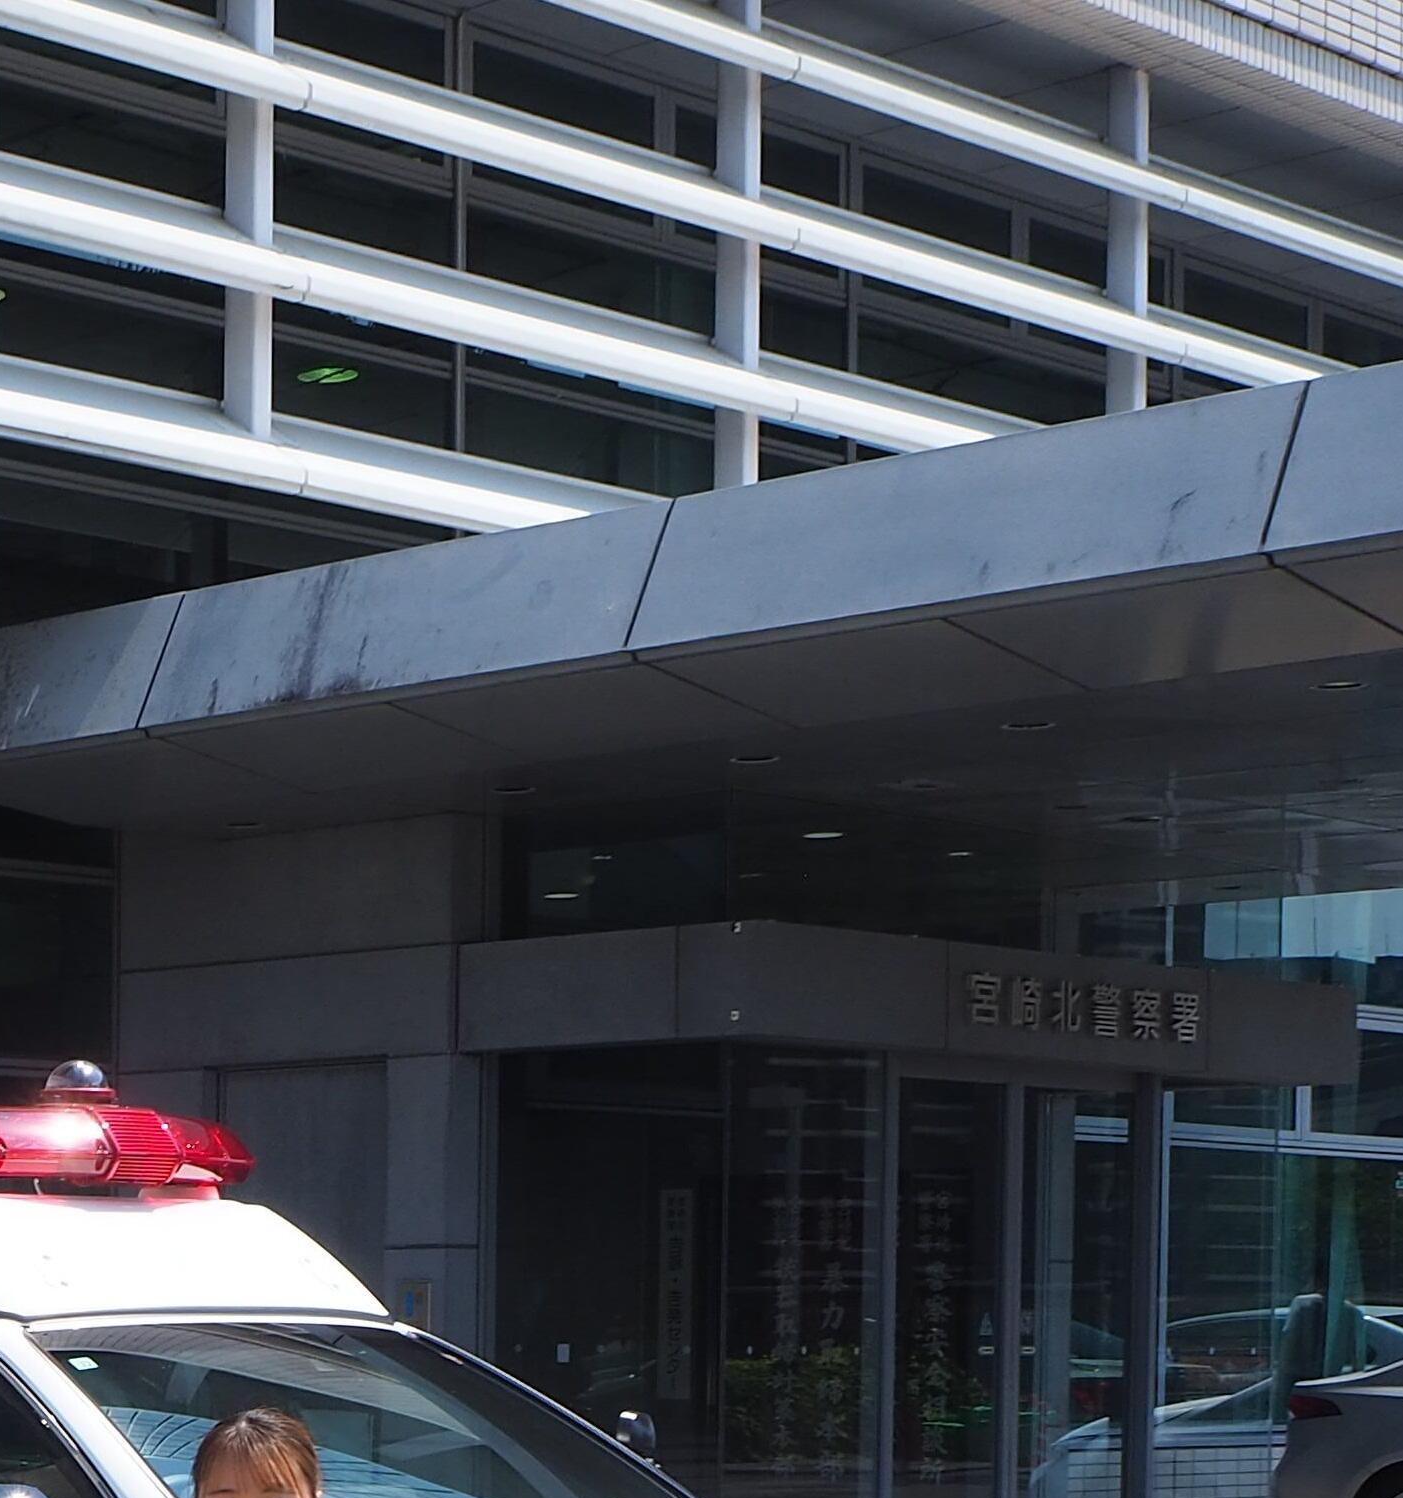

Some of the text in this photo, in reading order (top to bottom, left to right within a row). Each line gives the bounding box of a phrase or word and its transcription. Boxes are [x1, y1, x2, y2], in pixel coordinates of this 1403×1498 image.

[968, 972, 1201, 1044] 宮崎北警察署
